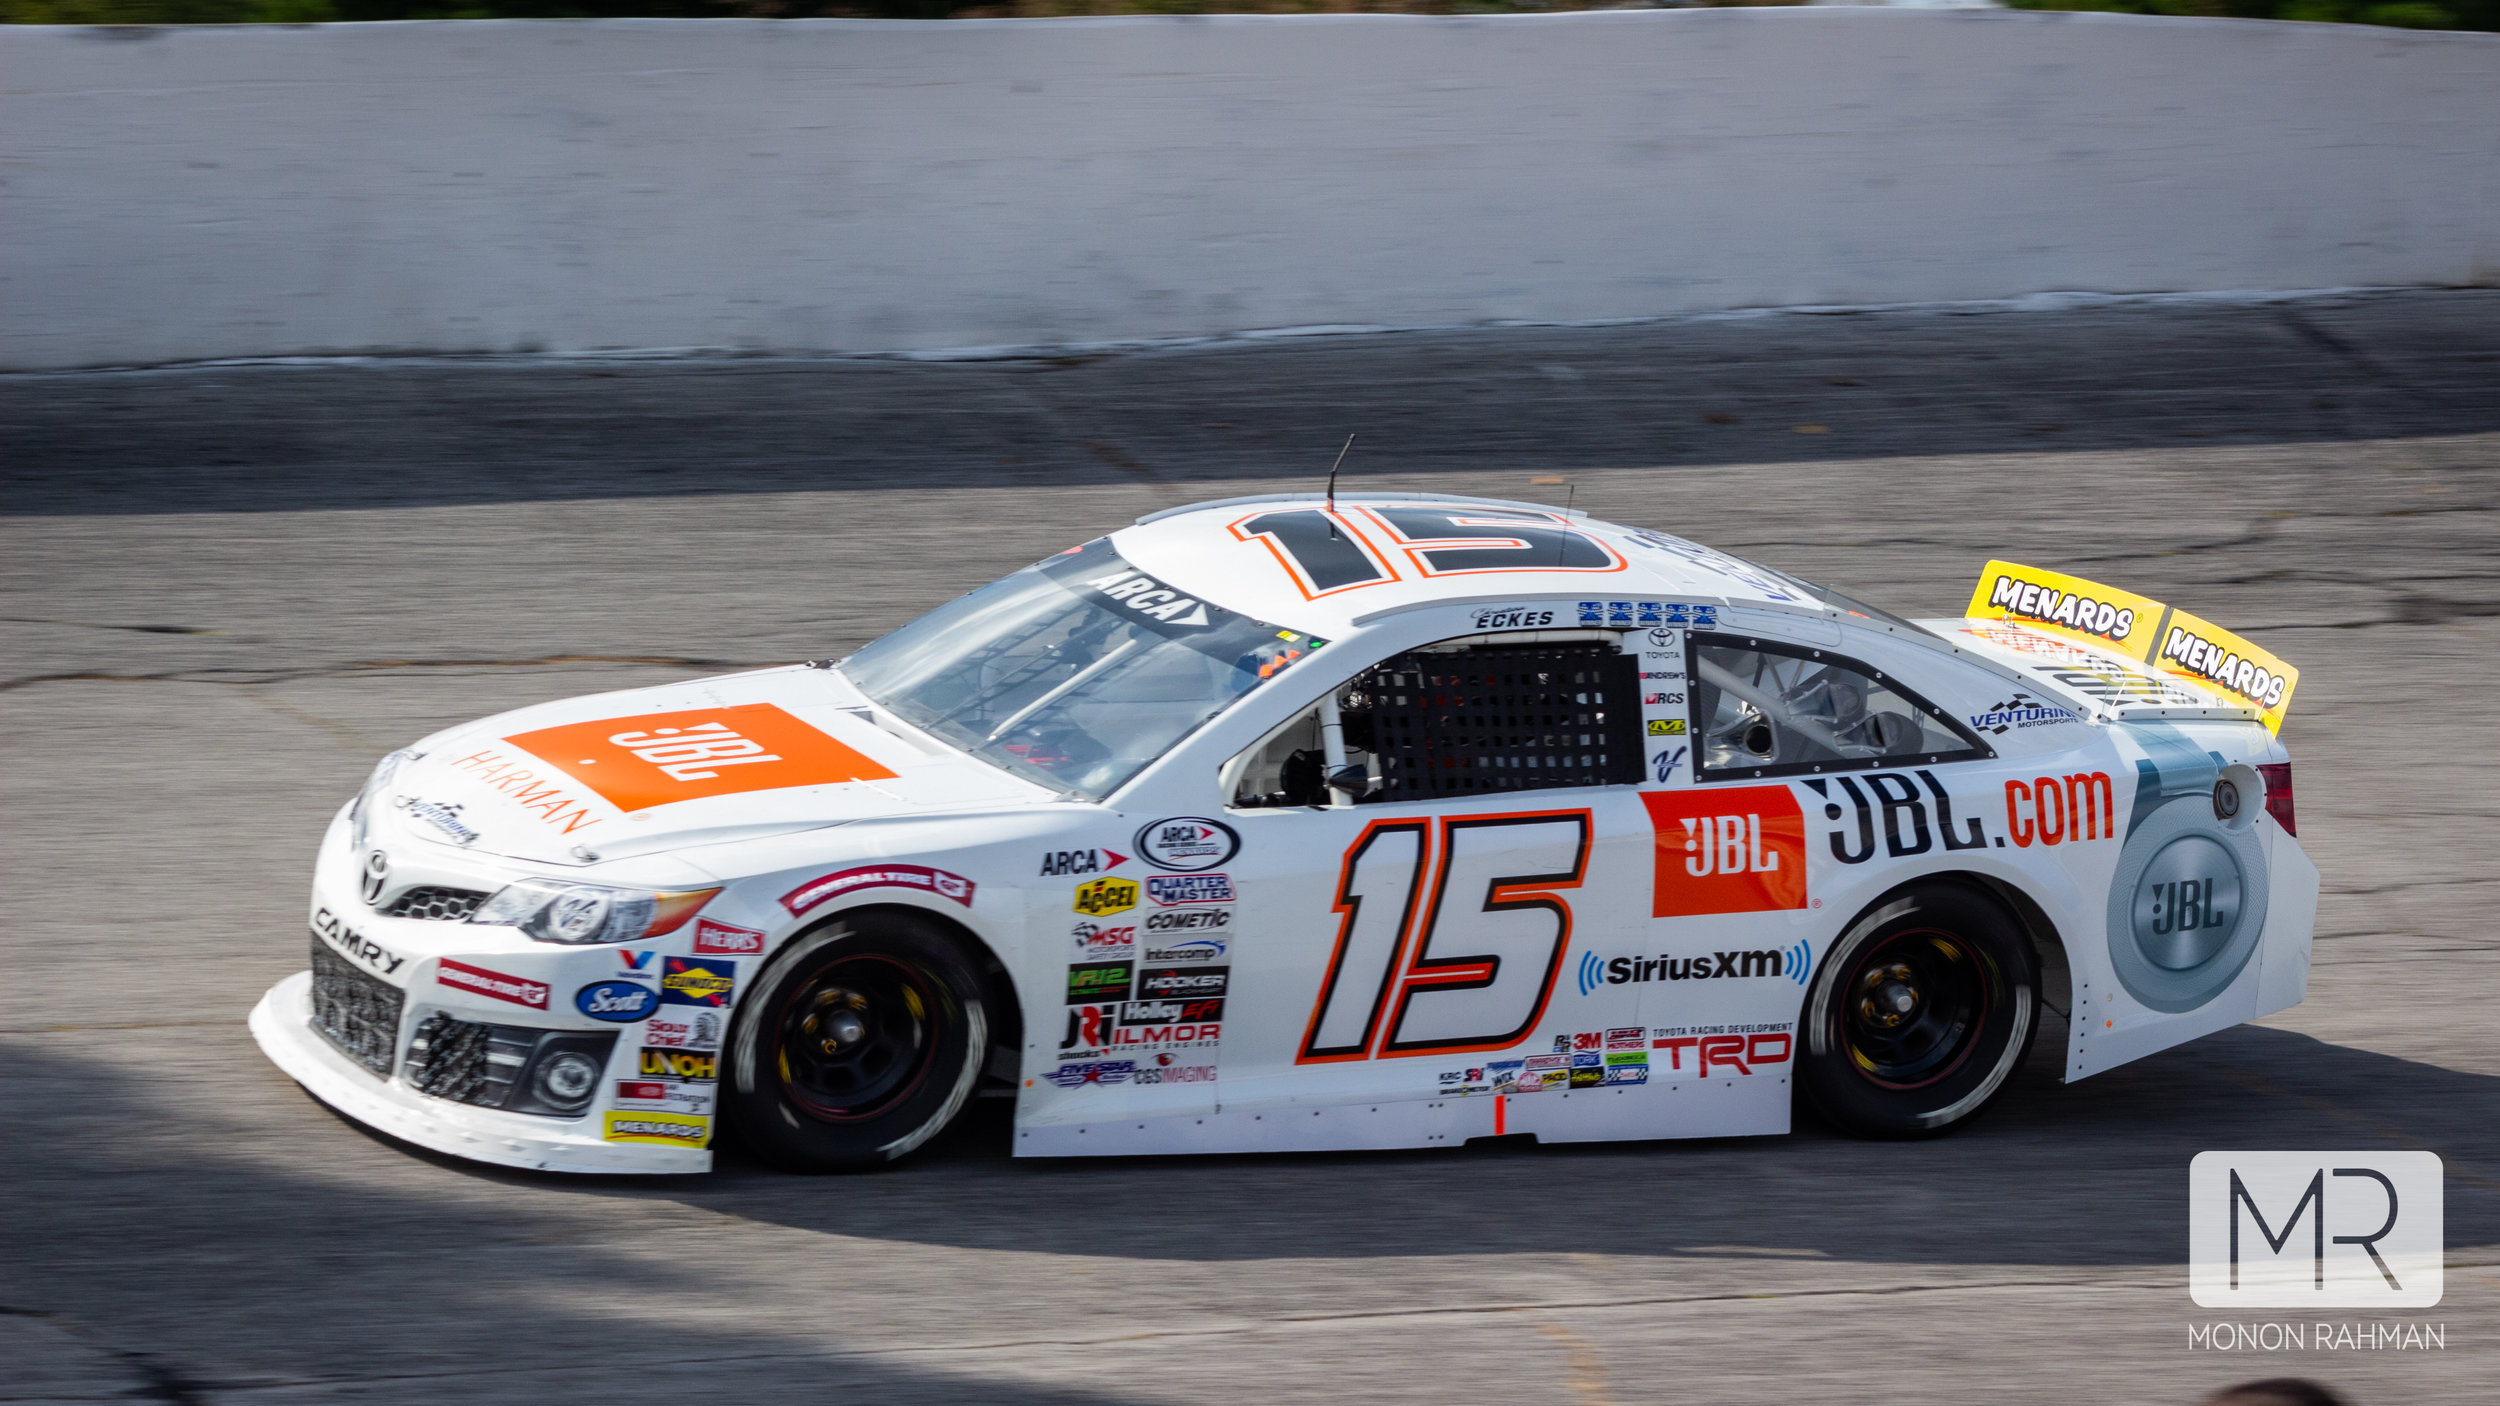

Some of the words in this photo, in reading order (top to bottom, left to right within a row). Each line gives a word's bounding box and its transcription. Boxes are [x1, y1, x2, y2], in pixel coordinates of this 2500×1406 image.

[1226, 505, 1628, 602] 15
[1087, 571, 1197, 621] ARCA
[1475, 611, 1554, 629] ECKES
[1988, 575, 2135, 643] MENARDS
[1646, 651, 1681, 659] TOYOTA
[2162, 627, 2286, 708] MENARDS
[1657, 692, 1684, 704] RCS
[2017, 717, 2079, 729] MOTORSPORTS
[609, 721, 783, 782] JBL
[451, 750, 603, 835] HARMAN
[1160, 826, 1197, 842] ARCA
[1680, 813, 1779, 877] JBL
[1041, 849, 1098, 876] ARCA
[1149, 876, 1228, 896] QUARTER
[1162, 887, 1232, 903] MASTER
[1077, 884, 1135, 913] ACCEL
[2151, 877, 2224, 936] JBL
[1146, 909, 1232, 930] COMETIC
[314, 906, 405, 975] CAMRY
[1086, 926, 1138, 946] MSG
[1294, 807, 1594, 1066] 15
[1144, 974, 1226, 991] HOOKER
[589, 987, 648, 1013] Scott
[1123, 1001, 1184, 1023] Holley
[1113, 1024, 1222, 1044] ILMOR
[1573, 1032, 1602, 1050] 3M
[1652, 1027, 1688, 1038] TOYOTA
[1689, 1024, 1726, 1036] RACING
[1727, 1022, 1794, 1034] DEVELOPMENT
[641, 1051, 717, 1078] UNOH
[1652, 1032, 1792, 1079] TRD
[612, 1120, 706, 1139] MENARDS
